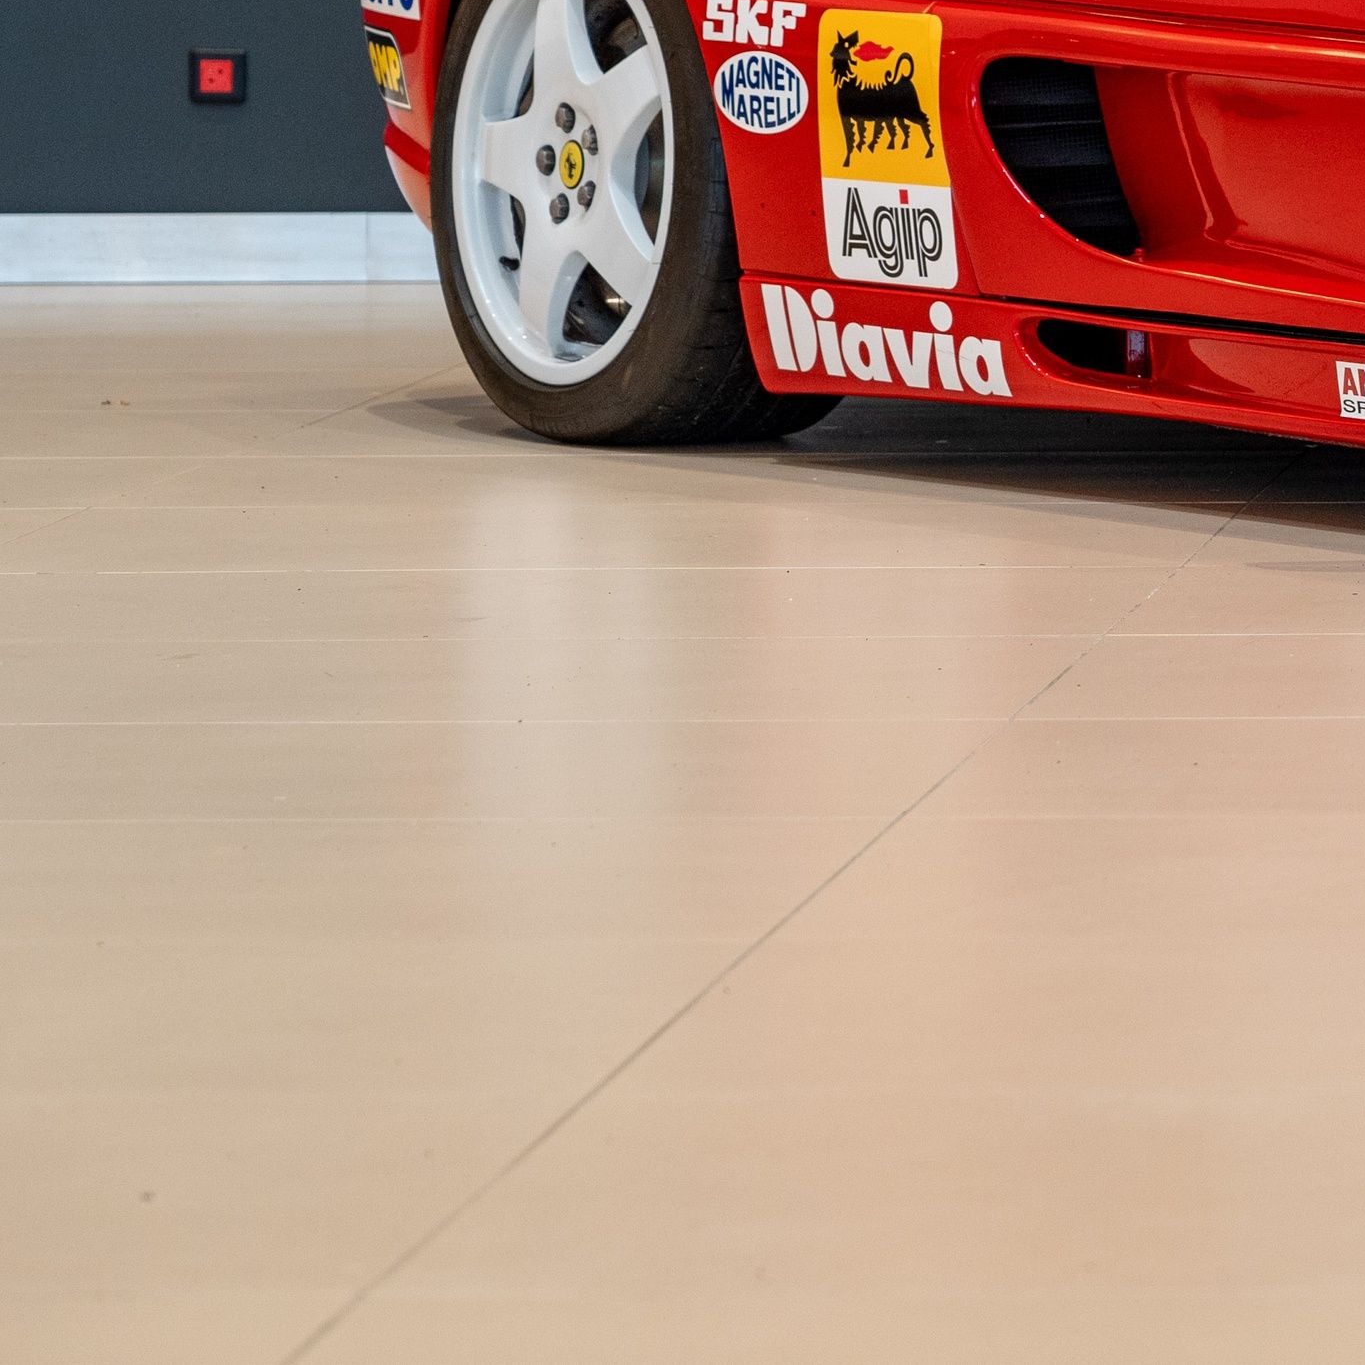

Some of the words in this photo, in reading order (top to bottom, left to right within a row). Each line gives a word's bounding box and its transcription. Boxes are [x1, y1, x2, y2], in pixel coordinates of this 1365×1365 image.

[721, 56, 800, 100] MAGNETI
[721, 81, 800, 129] MARELLI
[842, 187, 943, 278] Agip
[760, 283, 1014, 398] Diavia
